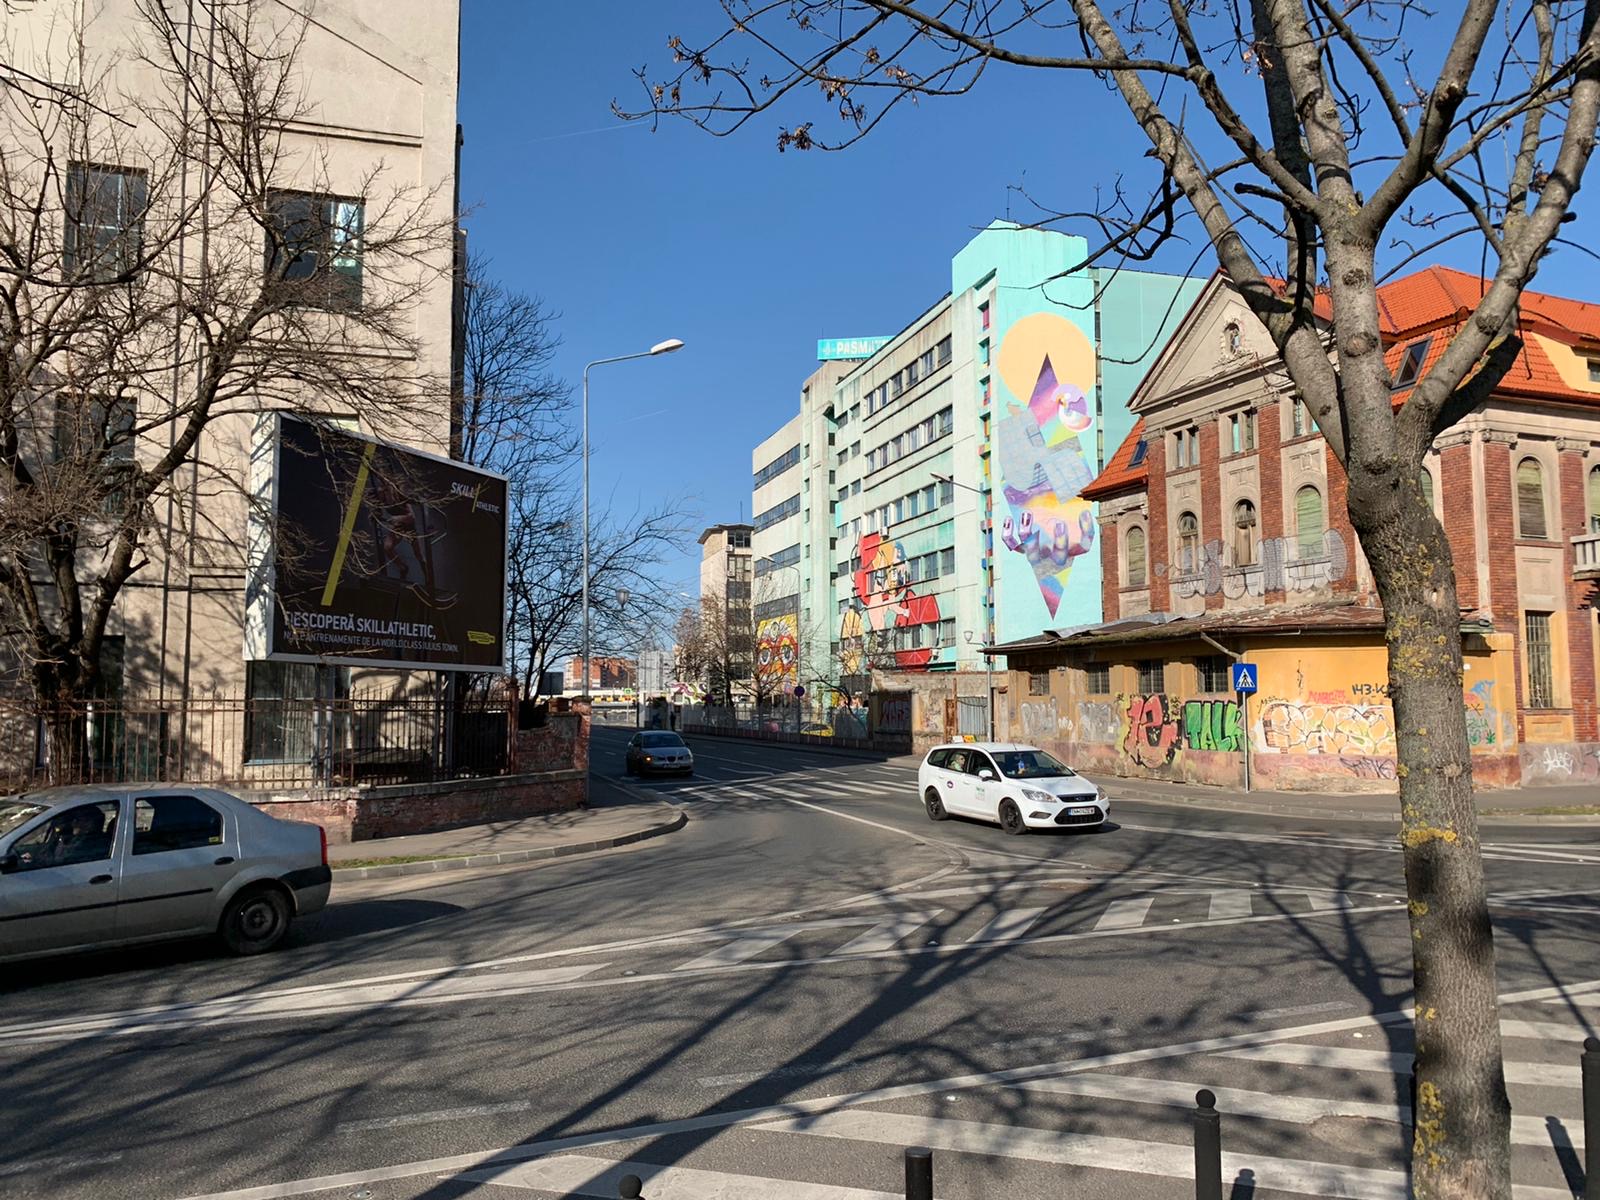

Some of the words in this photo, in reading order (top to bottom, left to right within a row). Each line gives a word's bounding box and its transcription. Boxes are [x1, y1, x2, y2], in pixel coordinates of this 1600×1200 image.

[285, 611, 355, 631] DESCOPERĂ
[357, 618, 437, 640] SKILLATHLETIC,
[1184, 700, 1243, 752] TALK
